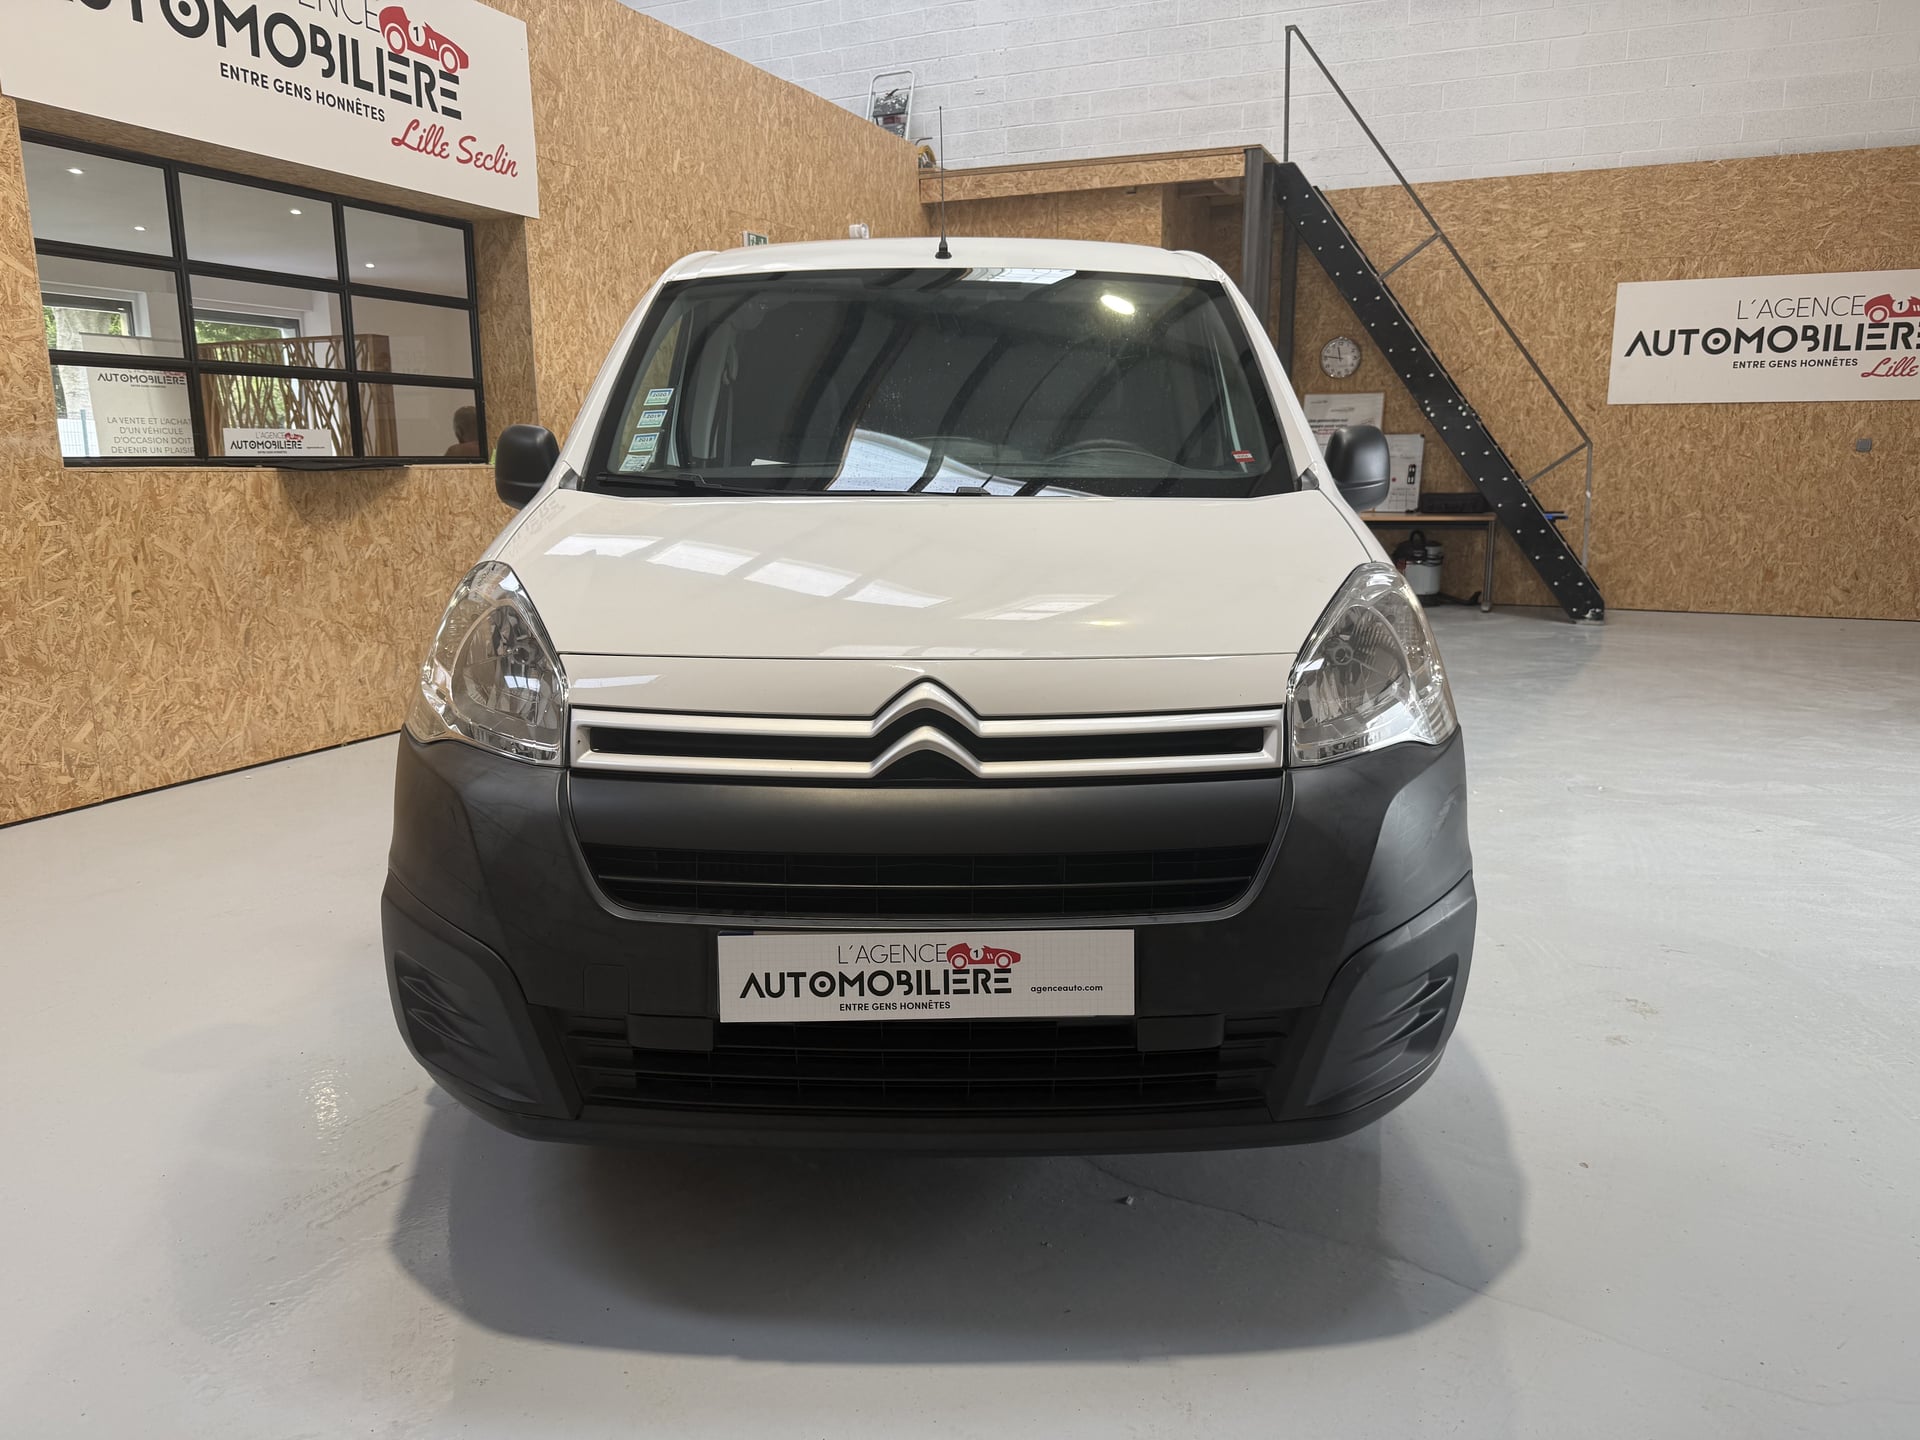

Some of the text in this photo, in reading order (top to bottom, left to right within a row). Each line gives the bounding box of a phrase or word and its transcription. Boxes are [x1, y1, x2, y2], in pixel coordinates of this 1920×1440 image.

[65, 0, 463, 121] OMOBILIERE
[220, 62, 386, 123] ENTRE GENS HONNÊTES
[391, 118, 518, 178] Lille Seclin
[1736, 294, 1866, 320] L'AGENCE
[1624, 321, 1920, 358] AUTOMOBILIER
[1732, 356, 1858, 369] ENTRE GENS HONNÊTES
[1860, 355, 1919, 378] Lille
[97, 372, 186, 386] AUTOMOBILIERE
[107, 416, 118, 424] LA
[119, 417, 146, 425] VENTE
[148, 417, 158, 425] ET
[119, 425, 184, 435] D'UN VÉHICULE
[113, 436, 192, 445] D'OCCASION DOIT
[230, 440, 303, 450] AUTOMOBILIERE
[111, 446, 148, 454] DEVENIR
[150, 446, 162, 454] UN
[837, 943, 948, 965] L'AGENCE
[739, 968, 1012, 999] AUTOMOBILIERE
[1030, 984, 1104, 994] agenceauto.com
[839, 1000, 951, 1012] ENTRE GENS HONNÊTES
